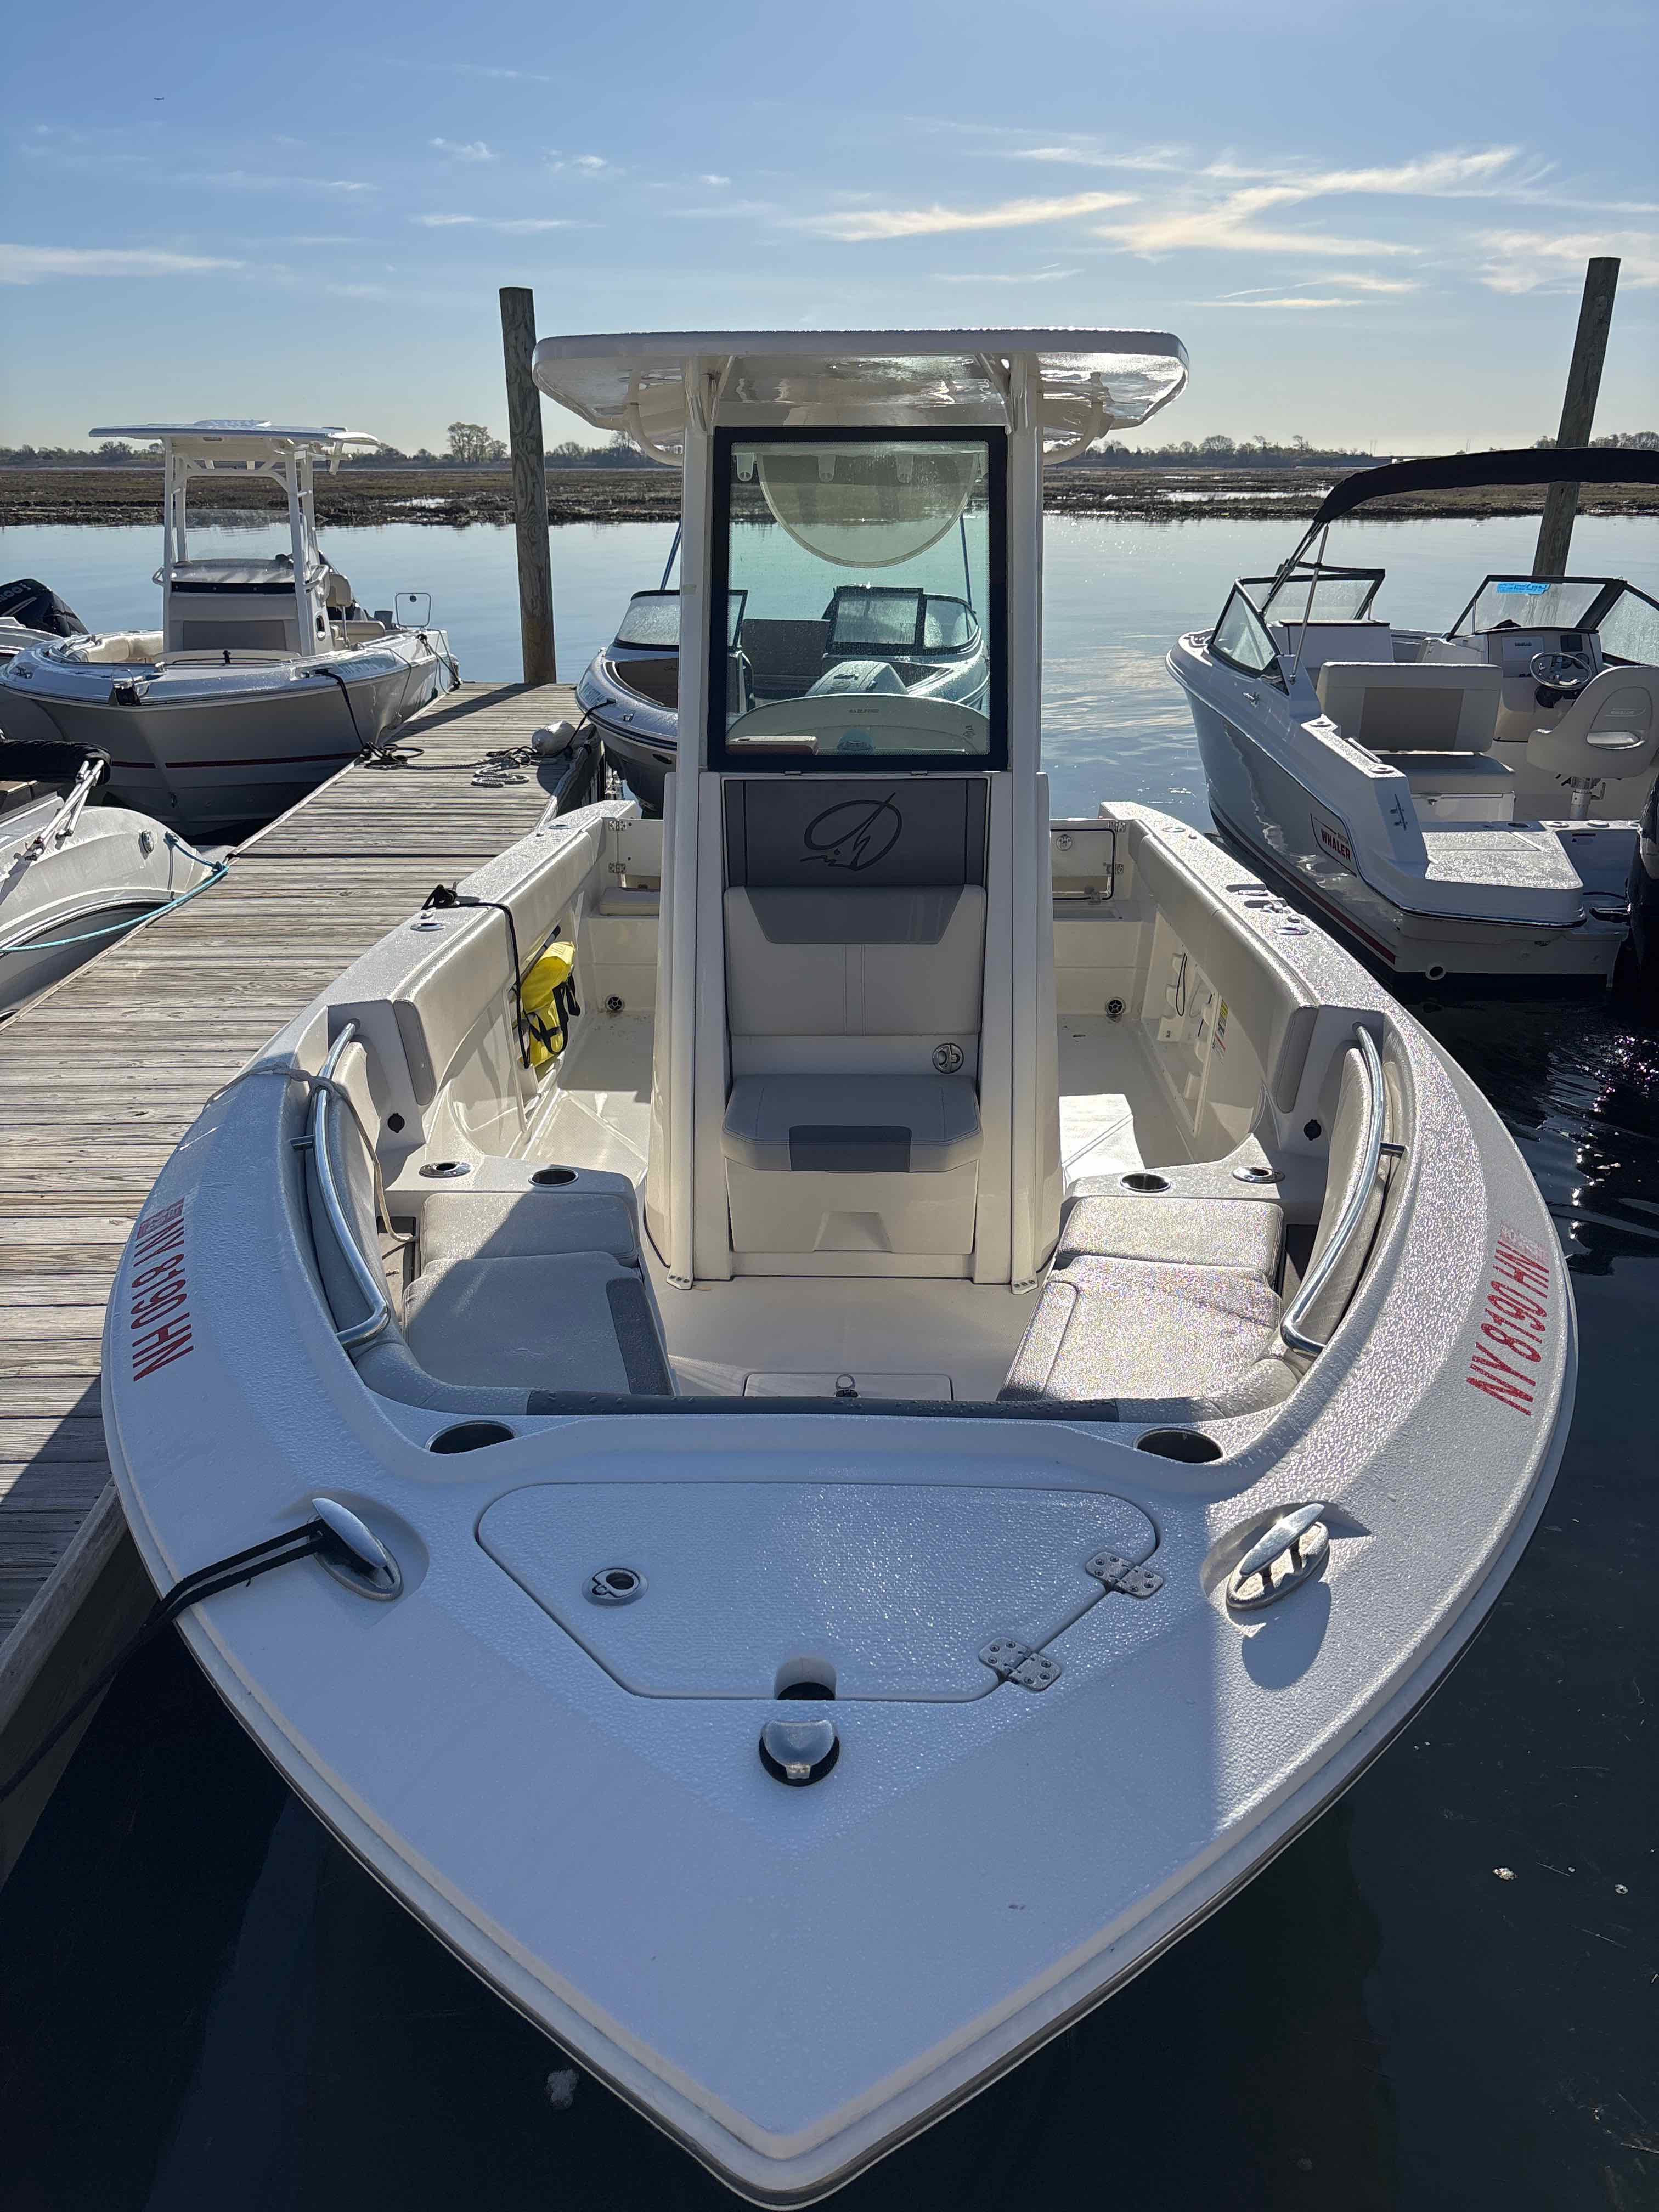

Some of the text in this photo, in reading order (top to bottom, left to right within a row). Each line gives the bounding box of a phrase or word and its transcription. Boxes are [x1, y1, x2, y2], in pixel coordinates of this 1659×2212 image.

[1321, 828, 1351, 861] WHALER
[131, 1253, 187, 1330] 8190
[1493, 1240, 1550, 1299] HN
[132, 1312, 194, 1383] HN
[1480, 1280, 1548, 1363] 8190
[1466, 1342, 1537, 1417] NY
